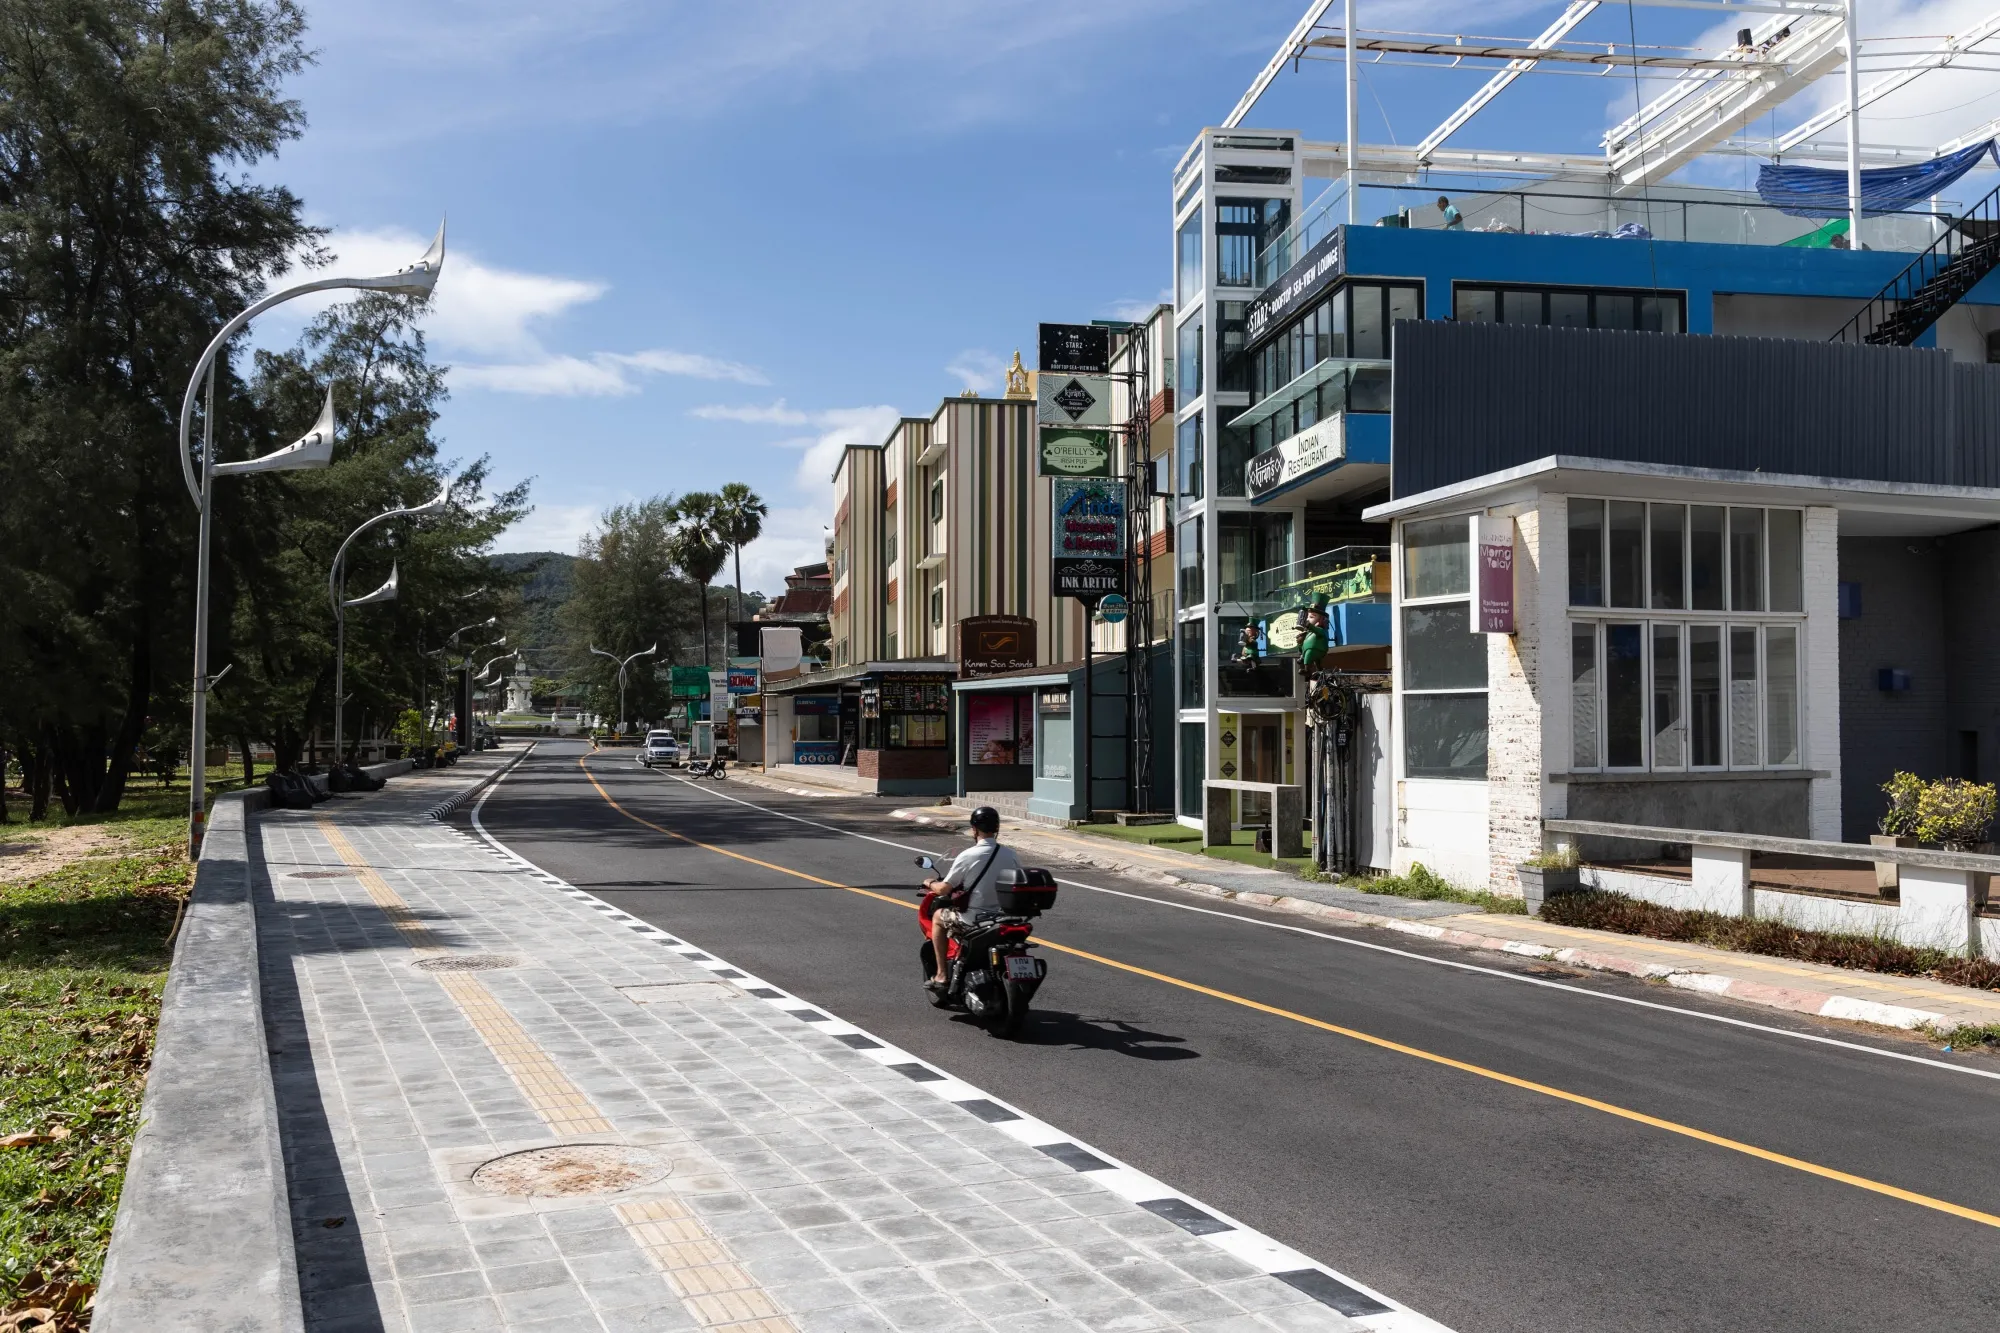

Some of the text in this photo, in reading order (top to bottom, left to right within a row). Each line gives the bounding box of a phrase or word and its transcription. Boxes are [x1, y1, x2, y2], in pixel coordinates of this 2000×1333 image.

[1250, 302, 1268, 333] STARZ
[1272, 286, 1292, 316] ROOFTOP
[1318, 246, 1338, 276] LOUNGE
[1053, 446, 1095, 456] O'REILLY'S
[1059, 488, 1124, 516] Anda
[1064, 519, 1117, 534] Massage
[1061, 576, 1118, 588] INK ARTTIC
[990, 658, 1006, 668] Sea
[1009, 659, 1034, 668] Sands
